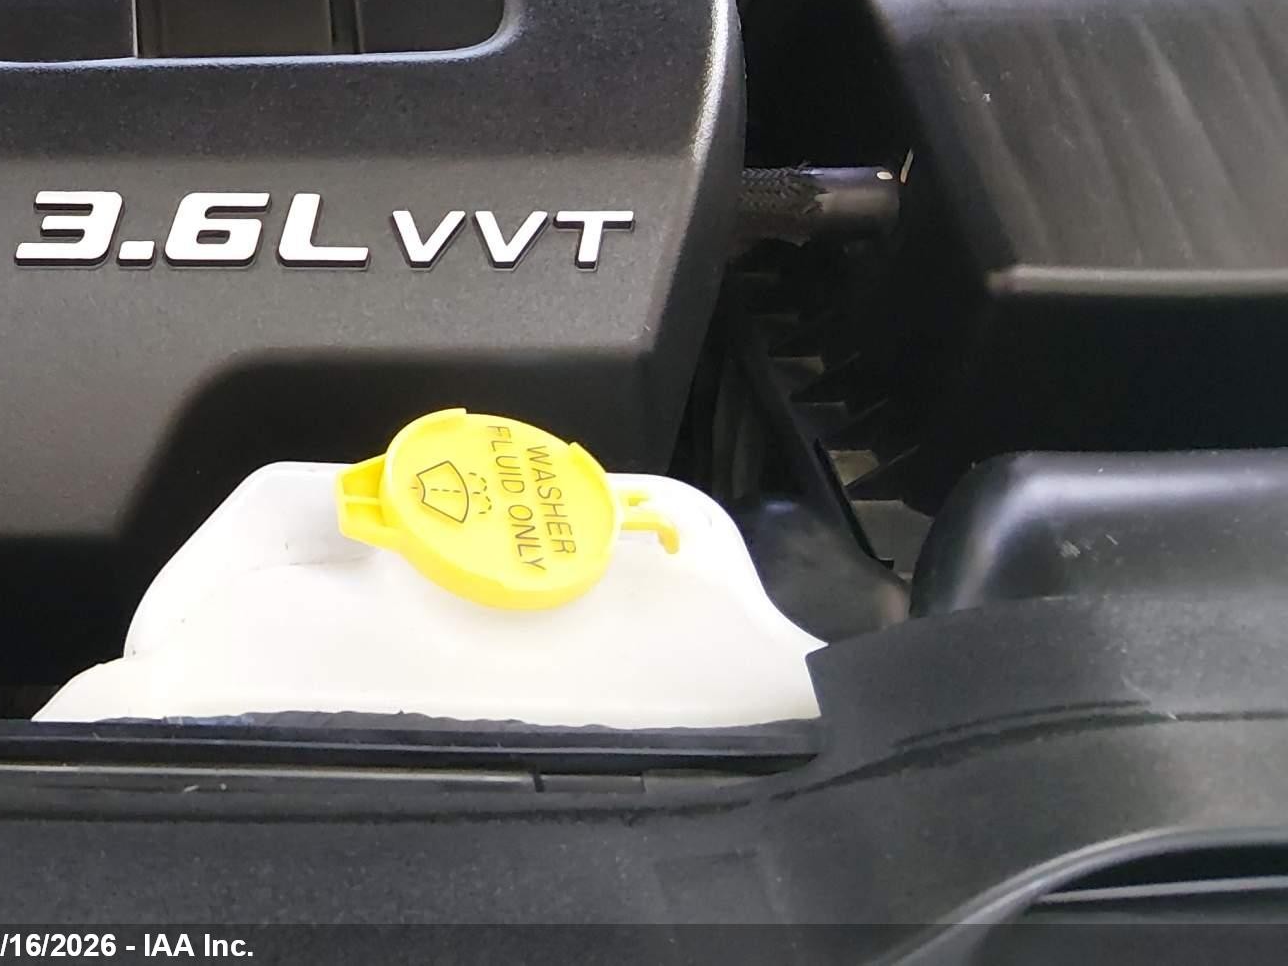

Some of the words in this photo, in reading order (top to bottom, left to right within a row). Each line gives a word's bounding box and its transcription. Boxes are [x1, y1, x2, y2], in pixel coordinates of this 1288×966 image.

[15, 190, 371, 268] 3.6L
[392, 210, 635, 270] VVT
[487, 425, 526, 494] FLUID
[508, 504, 547, 571] ONLY
[526, 445, 577, 554] WASHER
